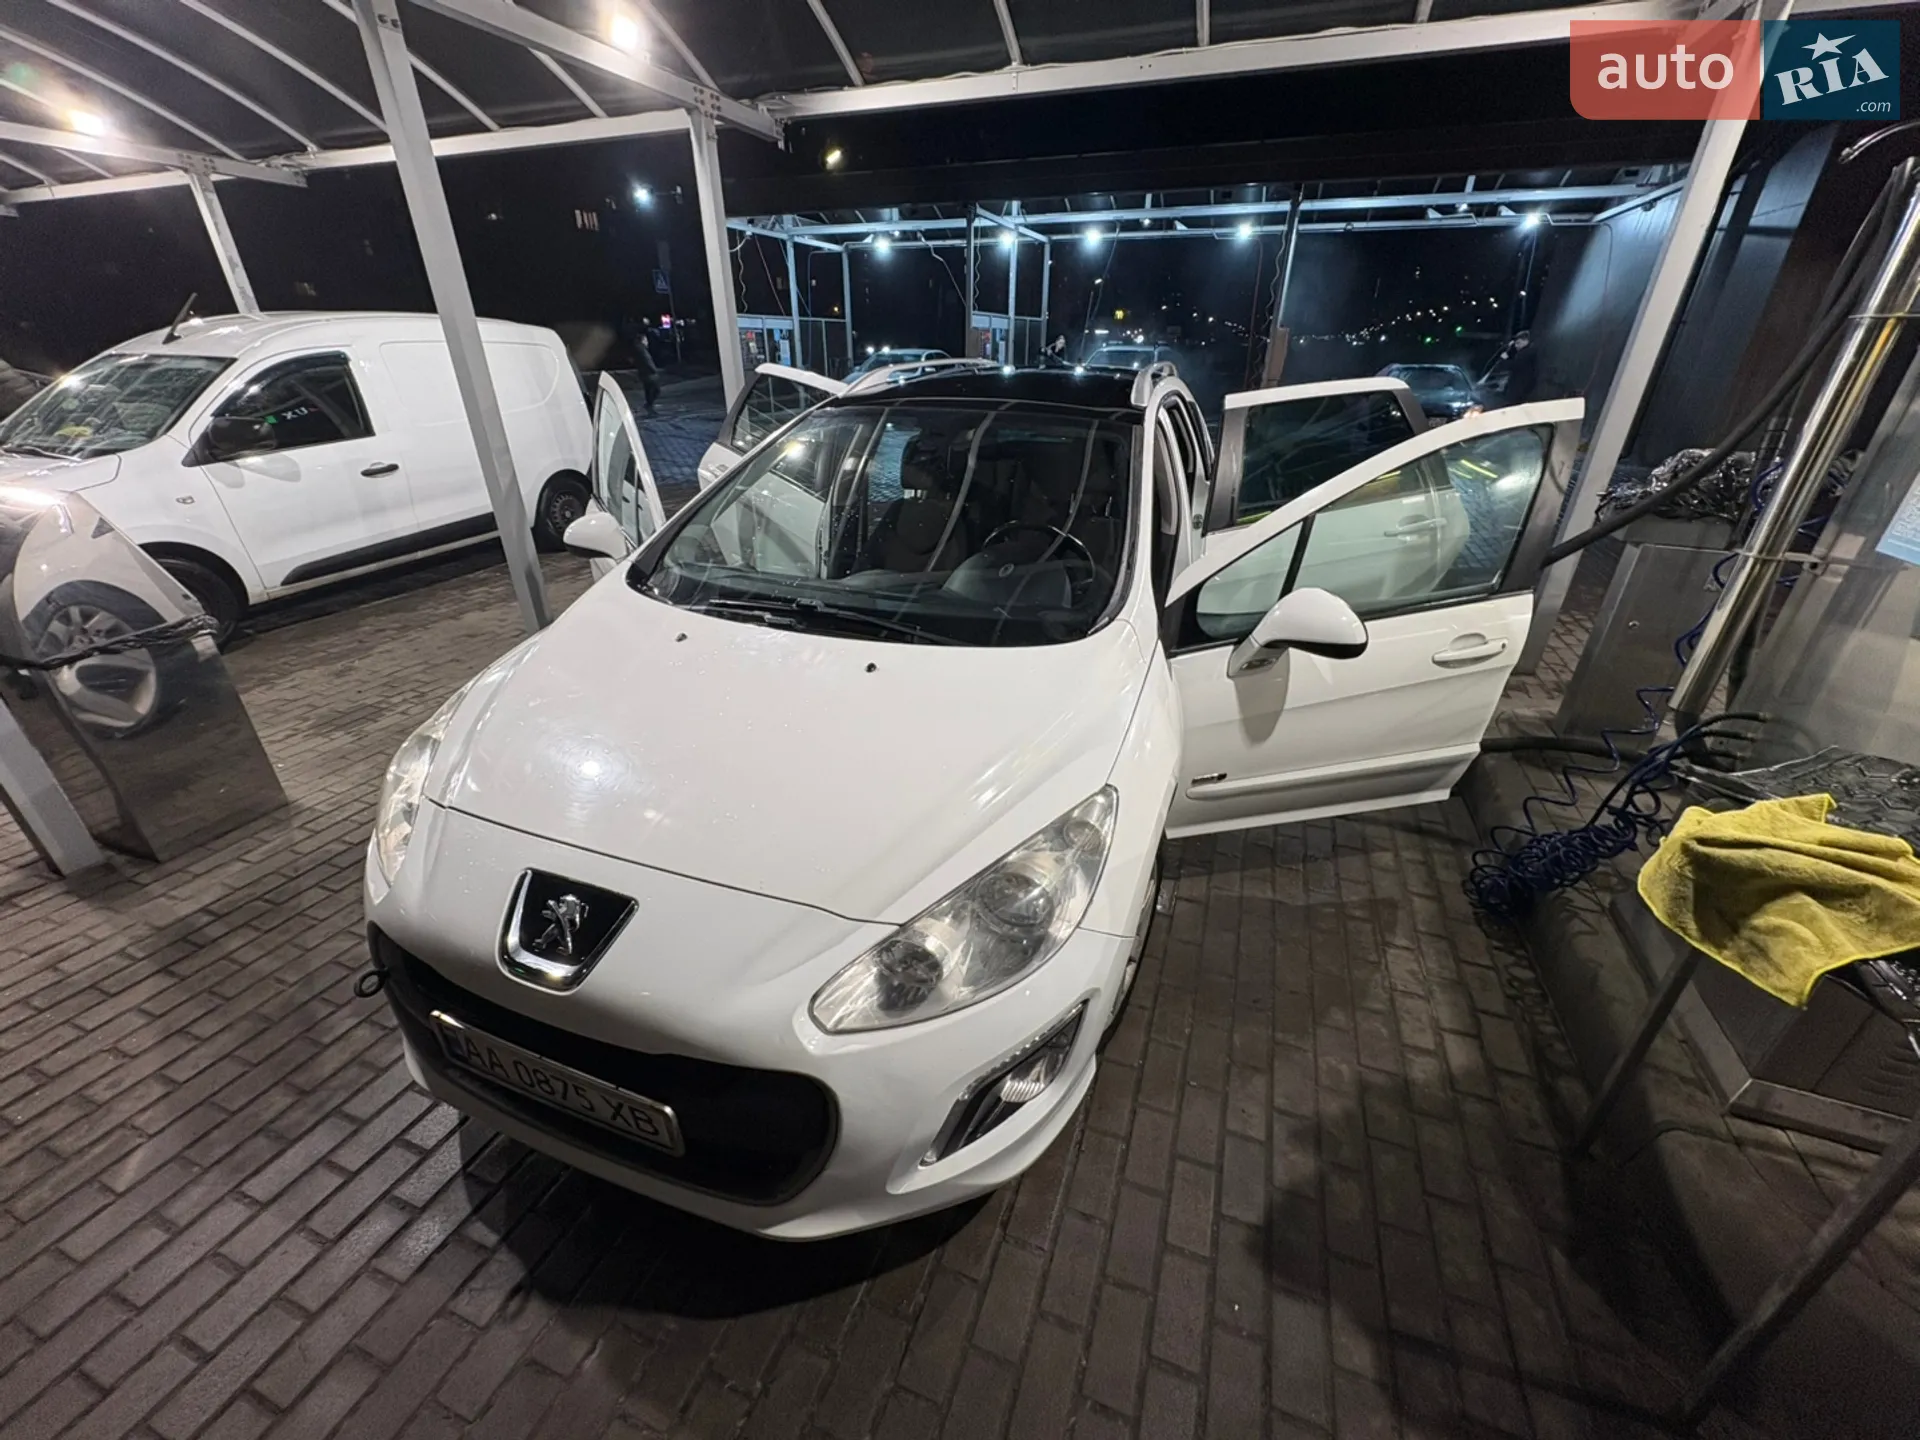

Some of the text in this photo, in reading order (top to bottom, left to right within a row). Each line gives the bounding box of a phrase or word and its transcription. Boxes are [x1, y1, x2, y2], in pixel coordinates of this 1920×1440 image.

[466, 1035, 660, 1137] AA 0875 XB
